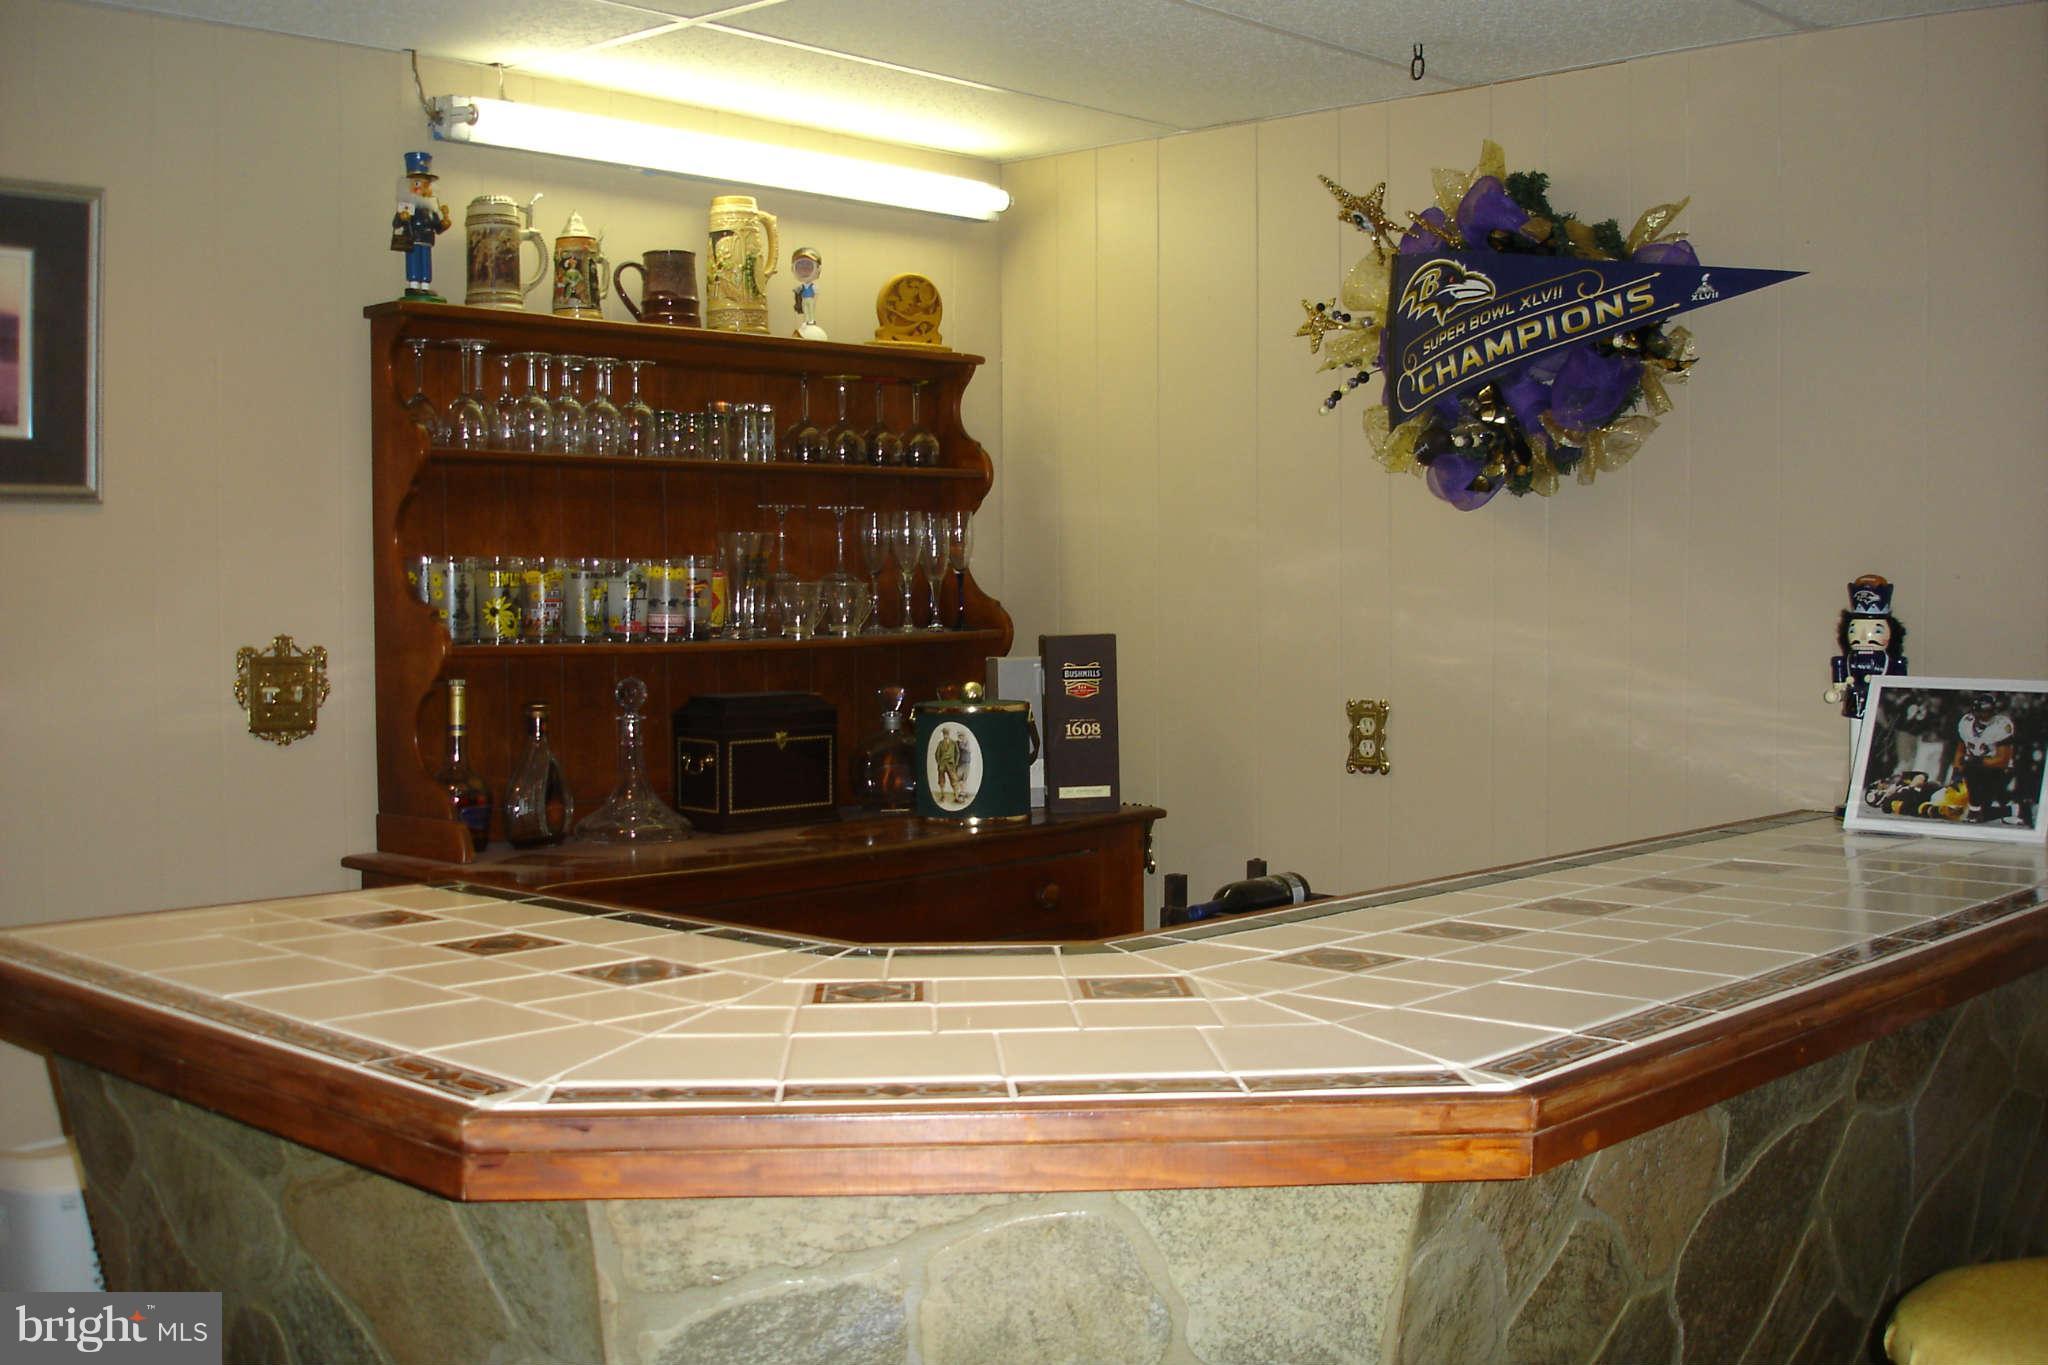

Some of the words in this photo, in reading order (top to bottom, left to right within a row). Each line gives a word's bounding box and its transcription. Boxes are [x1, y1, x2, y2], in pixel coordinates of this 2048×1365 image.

[1420, 268, 1440, 300] B
[1690, 290, 1720, 302] XLVII
[1422, 320, 1466, 356] SUPER
[1469, 303, 1515, 332] BOWL
[1519, 285, 1564, 311] XLVII
[1416, 283, 1657, 396] CHAMPIONS
[1064, 669, 1101, 679] BUSHMILLS
[1065, 722, 1101, 737] 1608
